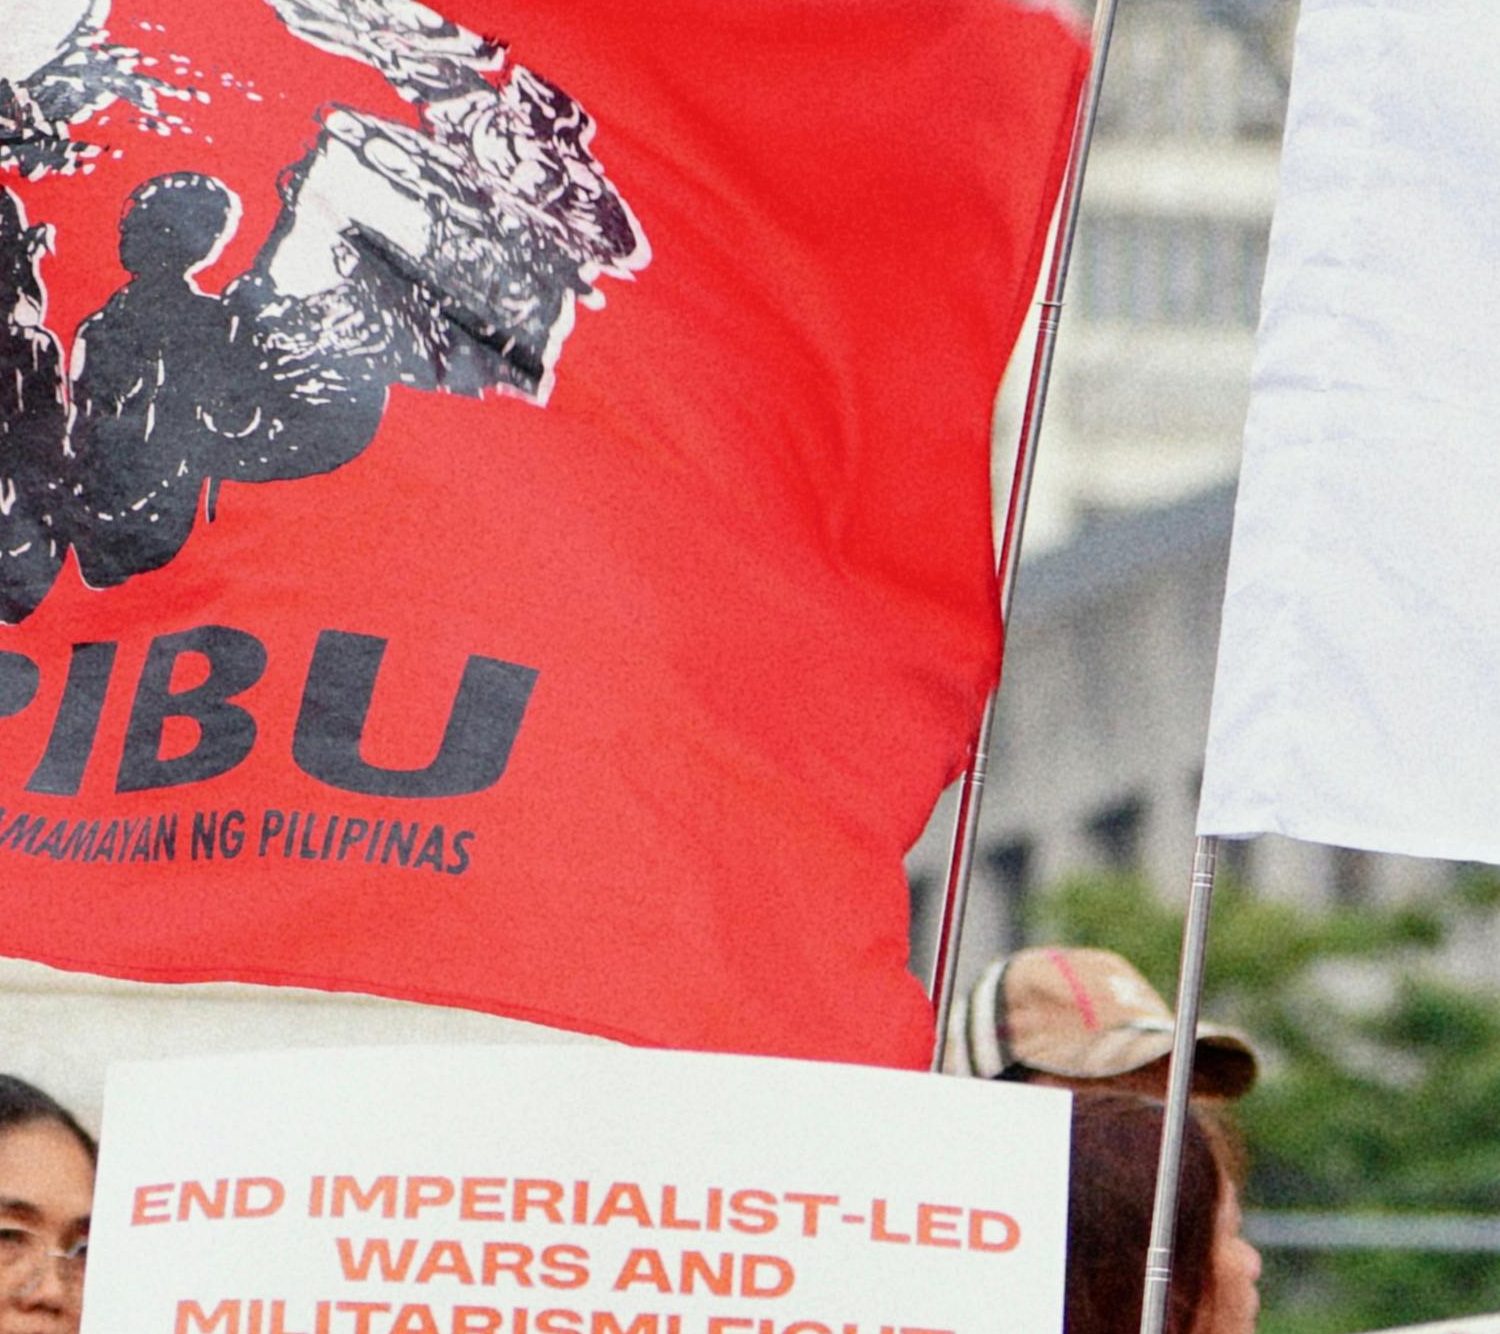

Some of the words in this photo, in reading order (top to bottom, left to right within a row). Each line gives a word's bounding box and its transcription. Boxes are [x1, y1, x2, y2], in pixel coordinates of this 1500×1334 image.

[190, 809, 246, 861] NG
[258, 808, 476, 875] PILIPINAS
[130, 1175, 286, 1227] END
[308, 1174, 1022, 1254] IMPERIALIST-LED
[335, 1236, 590, 1291] WARS
[612, 1247, 796, 1299] AND
